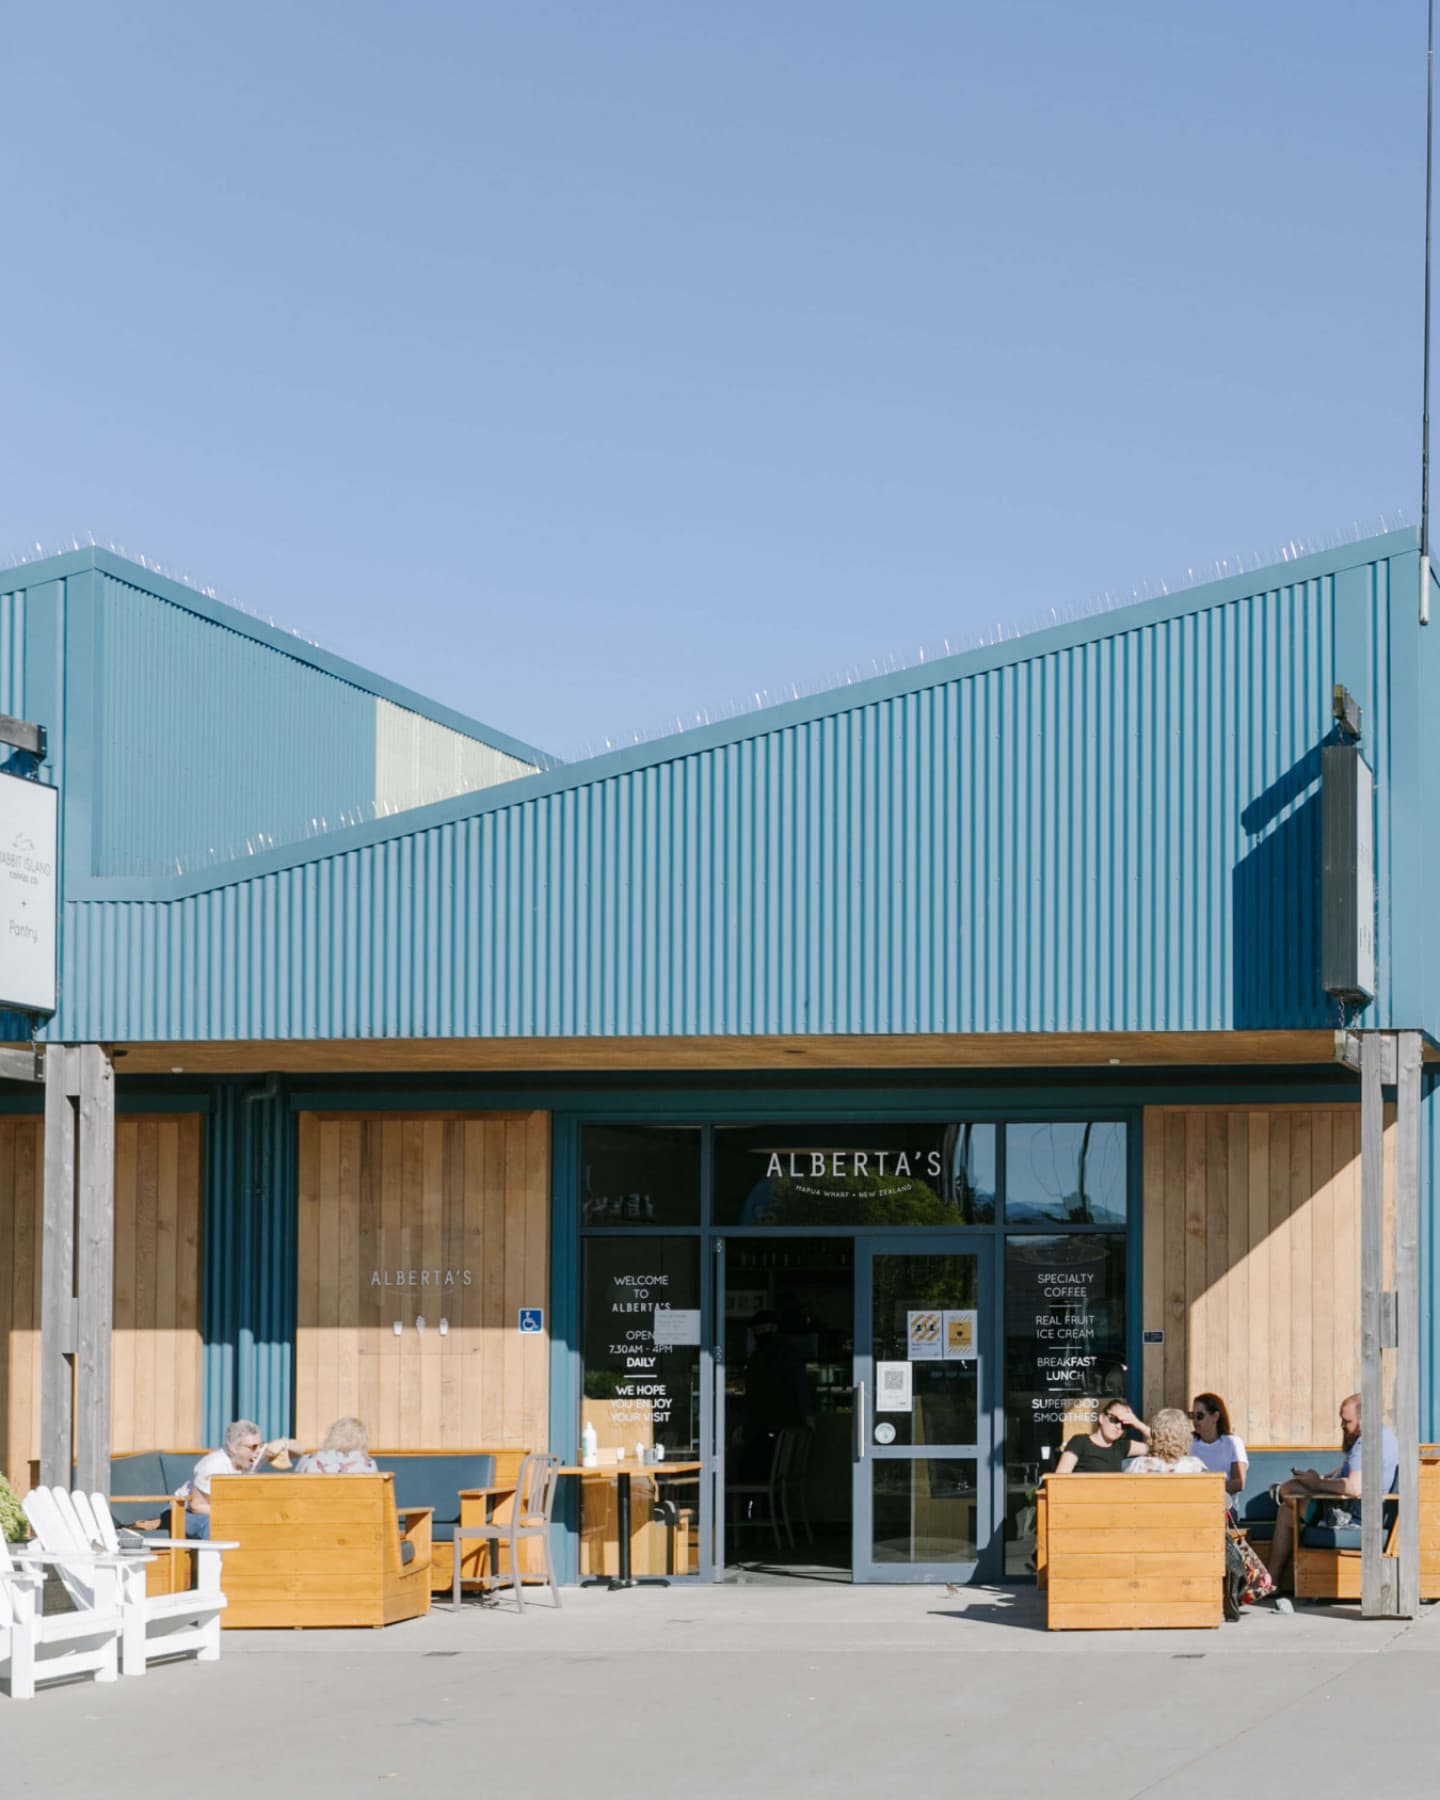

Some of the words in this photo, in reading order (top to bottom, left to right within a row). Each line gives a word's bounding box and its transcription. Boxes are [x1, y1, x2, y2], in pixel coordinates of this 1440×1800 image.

[0, 849, 22, 870] ABBIT
[9, 919, 38, 944] Pantry
[766, 1151, 942, 1177] ALBERTA'S
[795, 1184, 821, 1196] MAPUA
[823, 1190, 850, 1198] WHARF
[858, 1190, 877, 1199] NEW
[879, 1183, 912, 1197] ZEALAND
[370, 1270, 473, 1286] ALBERTA'S
[613, 1275, 669, 1286] WELCOME
[1037, 1273, 1094, 1284] SPECIALTY
[633, 1288, 650, 1299] TO
[1043, 1286, 1087, 1298] COFFEE
[611, 1302, 672, 1313] ALBERTA'S
[1035, 1315, 1062, 1326] REAL
[1064, 1314, 1096, 1326] FRUIT
[625, 1330, 656, 1341] OPEN
[1036, 1328, 1055, 1340] ICE
[1057, 1328, 1095, 1340] CREAM
[652, 1343, 673, 1353] 4PM
[626, 1357, 656, 1368] DAILY
[1036, 1355, 1097, 1367] BREAKFAST
[1046, 1369, 1085, 1381] LUNCH
[615, 1385, 635, 1396] WE
[637, 1385, 667, 1396] HOPE
[610, 1398, 635, 1409] YOU
[636, 1398, 672, 1409] ENJOY
[1031, 1398, 1100, 1409] SUPERFOOD
[611, 1412, 641, 1423] YOUR
[644, 1411, 671, 1423] VISIT
[1033, 1411, 1099, 1423] SMOOTHIES
